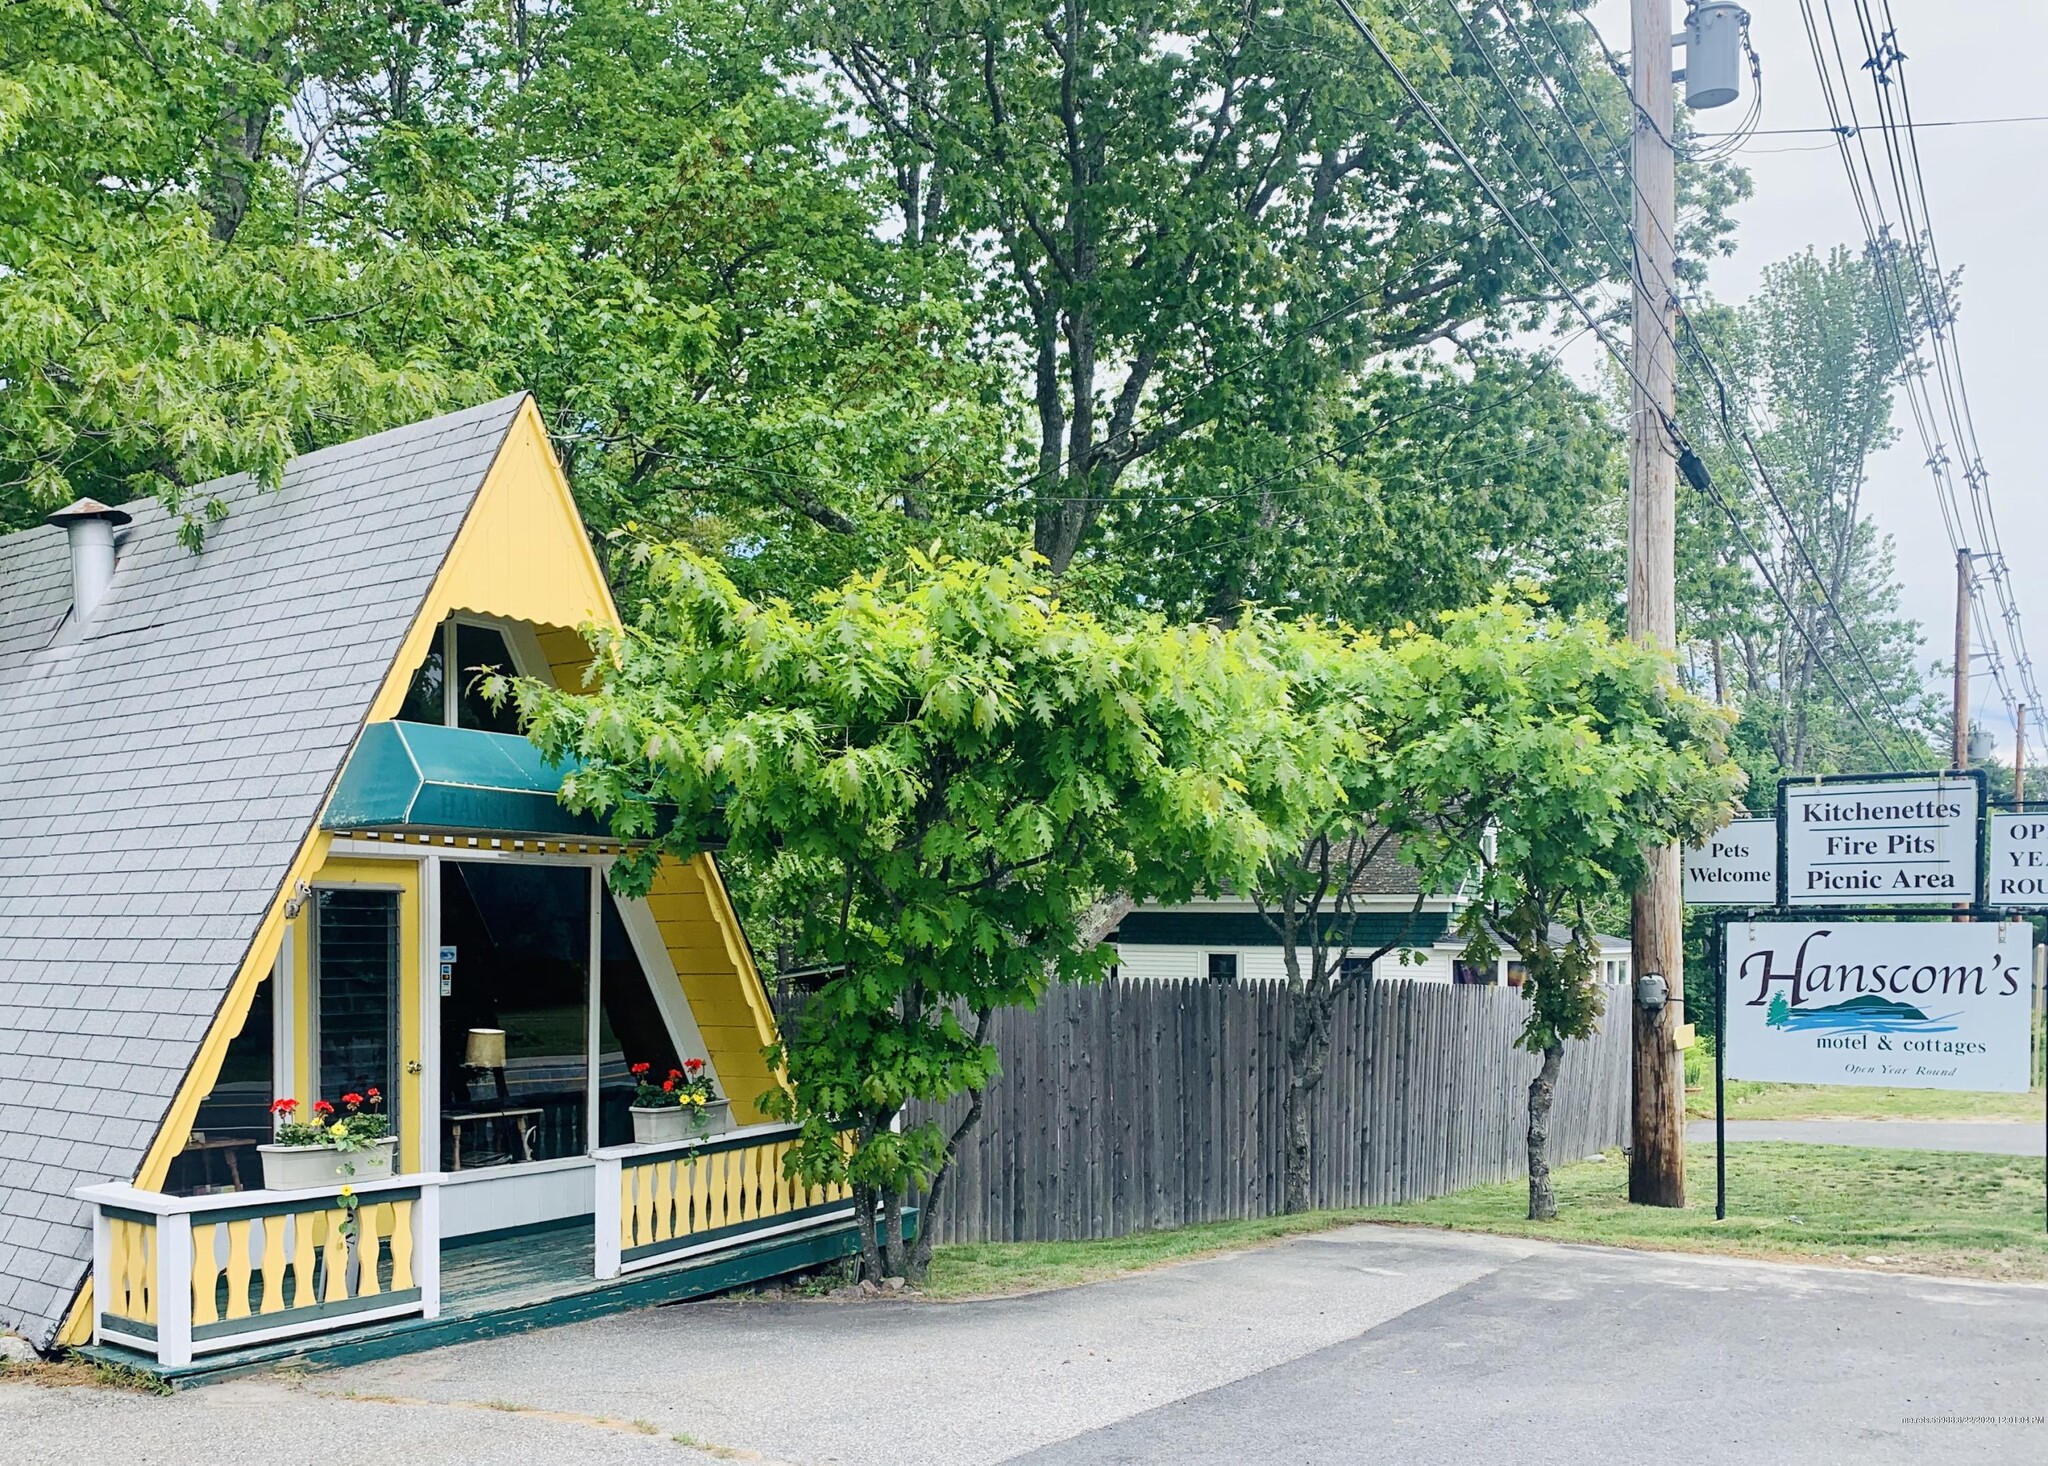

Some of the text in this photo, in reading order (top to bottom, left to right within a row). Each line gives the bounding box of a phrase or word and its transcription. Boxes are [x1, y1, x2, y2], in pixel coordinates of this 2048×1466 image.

[1803, 800, 1961, 823] Kitchenettes
[2009, 823, 2048, 841] OP
[1711, 842, 1749, 859] Pets
[1827, 834, 1936, 856] Fire Pits
[2008, 851, 2048, 868] YE
[1689, 867, 1772, 883] Welcome
[1806, 869, 1956, 890] Picnic Area
[1740, 930, 2021, 1008] Hanscom's
[1816, 1034, 1987, 1056] motel & cottages
[1844, 1063, 1958, 1077] Open Year Round
